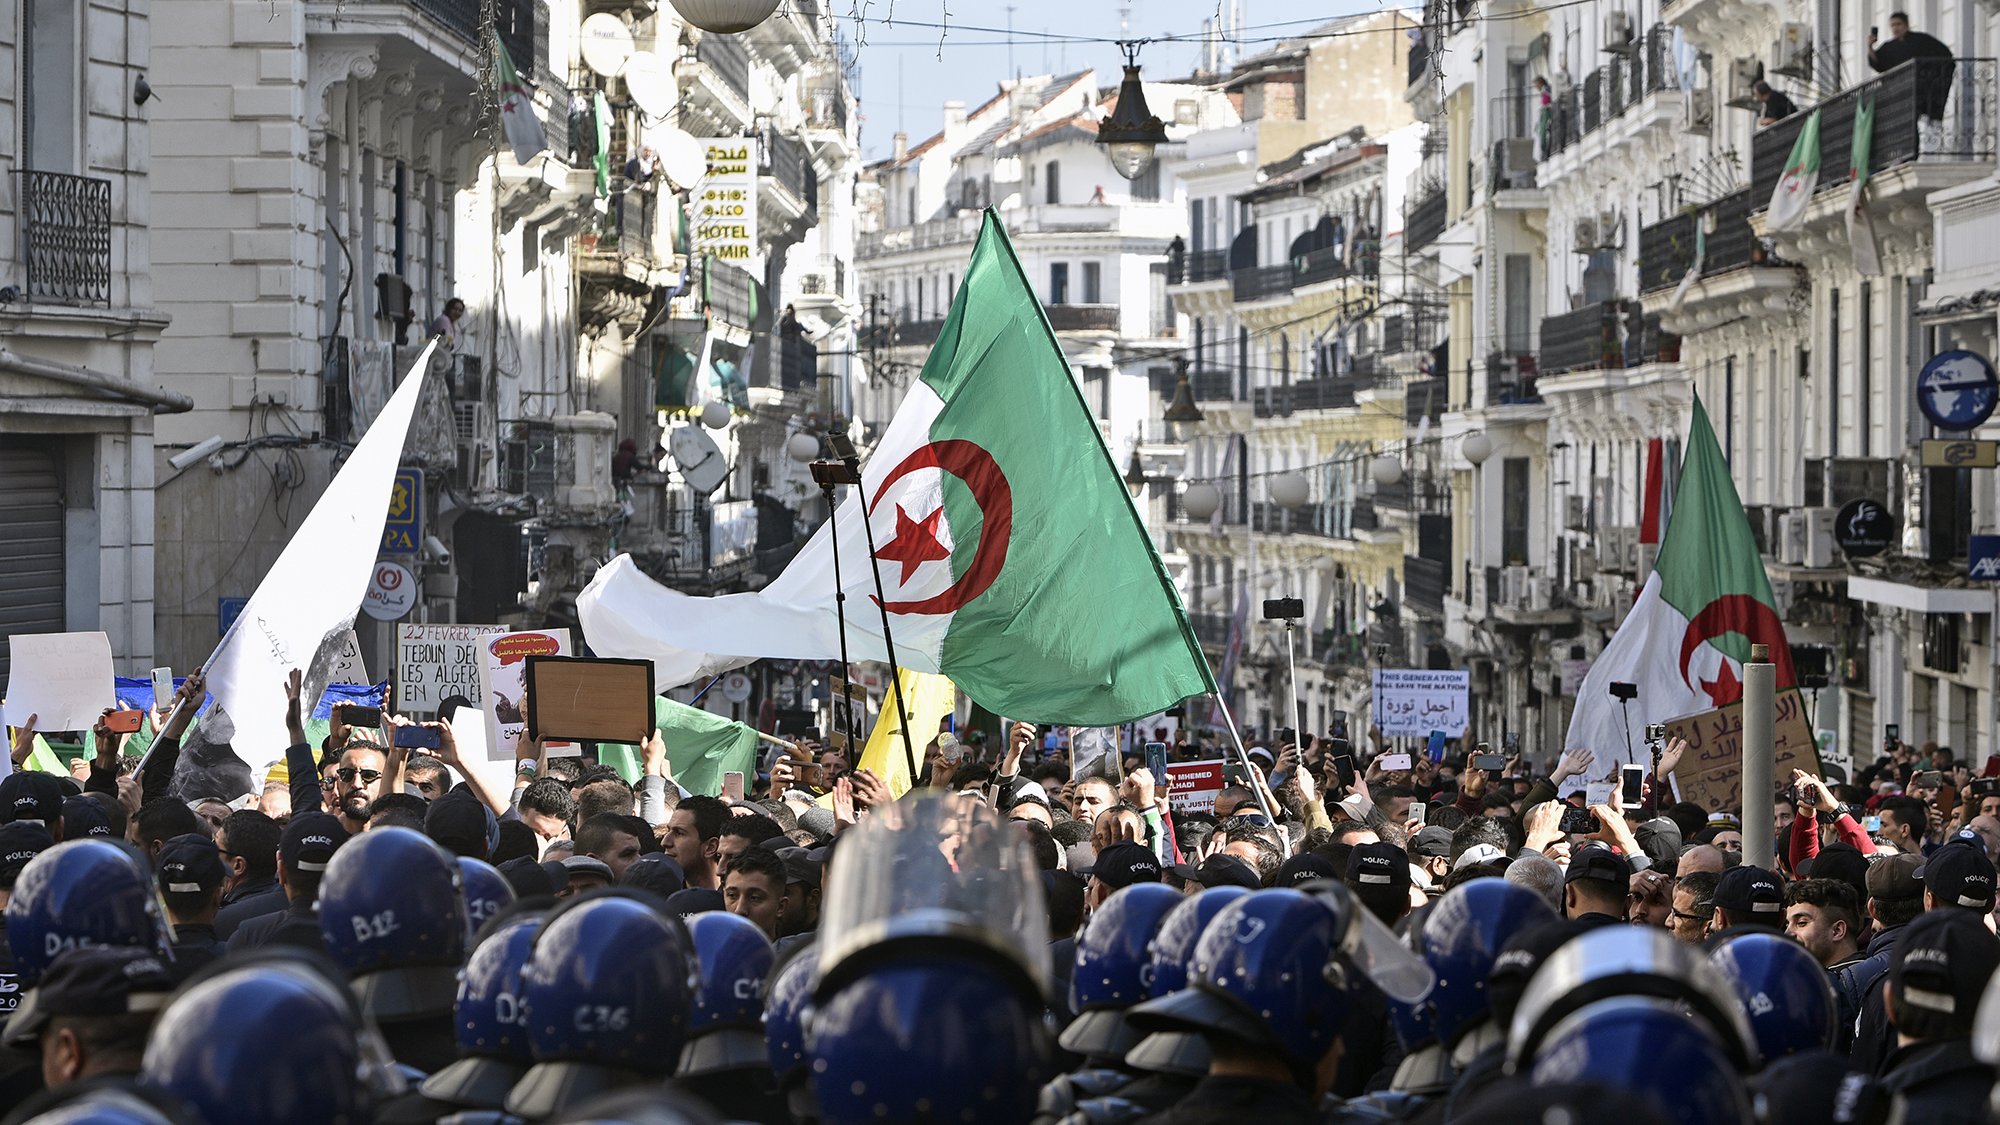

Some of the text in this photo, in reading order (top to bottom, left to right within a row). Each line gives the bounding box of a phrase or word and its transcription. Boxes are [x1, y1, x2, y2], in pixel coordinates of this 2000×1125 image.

[697, 225, 750, 239] HOTEL
[697, 245, 749, 258] SAMIR
[404, 625, 425, 640] 22
[402, 643, 446, 664] TEBOUN
[401, 664, 423, 683] LES
[1402, 673, 1463, 682] GENERATION
[1433, 682, 1466, 691] NATION
[404, 684, 427, 702] EN
[1177, 771, 1213, 781] MHEMED
[1171, 781, 1195, 790] LHADI
[1169, 792, 1189, 801] ERTÉ
[14, 797, 39, 808] POLICE
[1188, 799, 1215, 808] JUSTIC
[302, 835, 333, 846] POLICE
[1480, 847, 1501, 858] LA
[1362, 857, 1391, 866] POLICE
[1965, 875, 1989, 884] POLICE
[350, 908, 400, 943] B12
